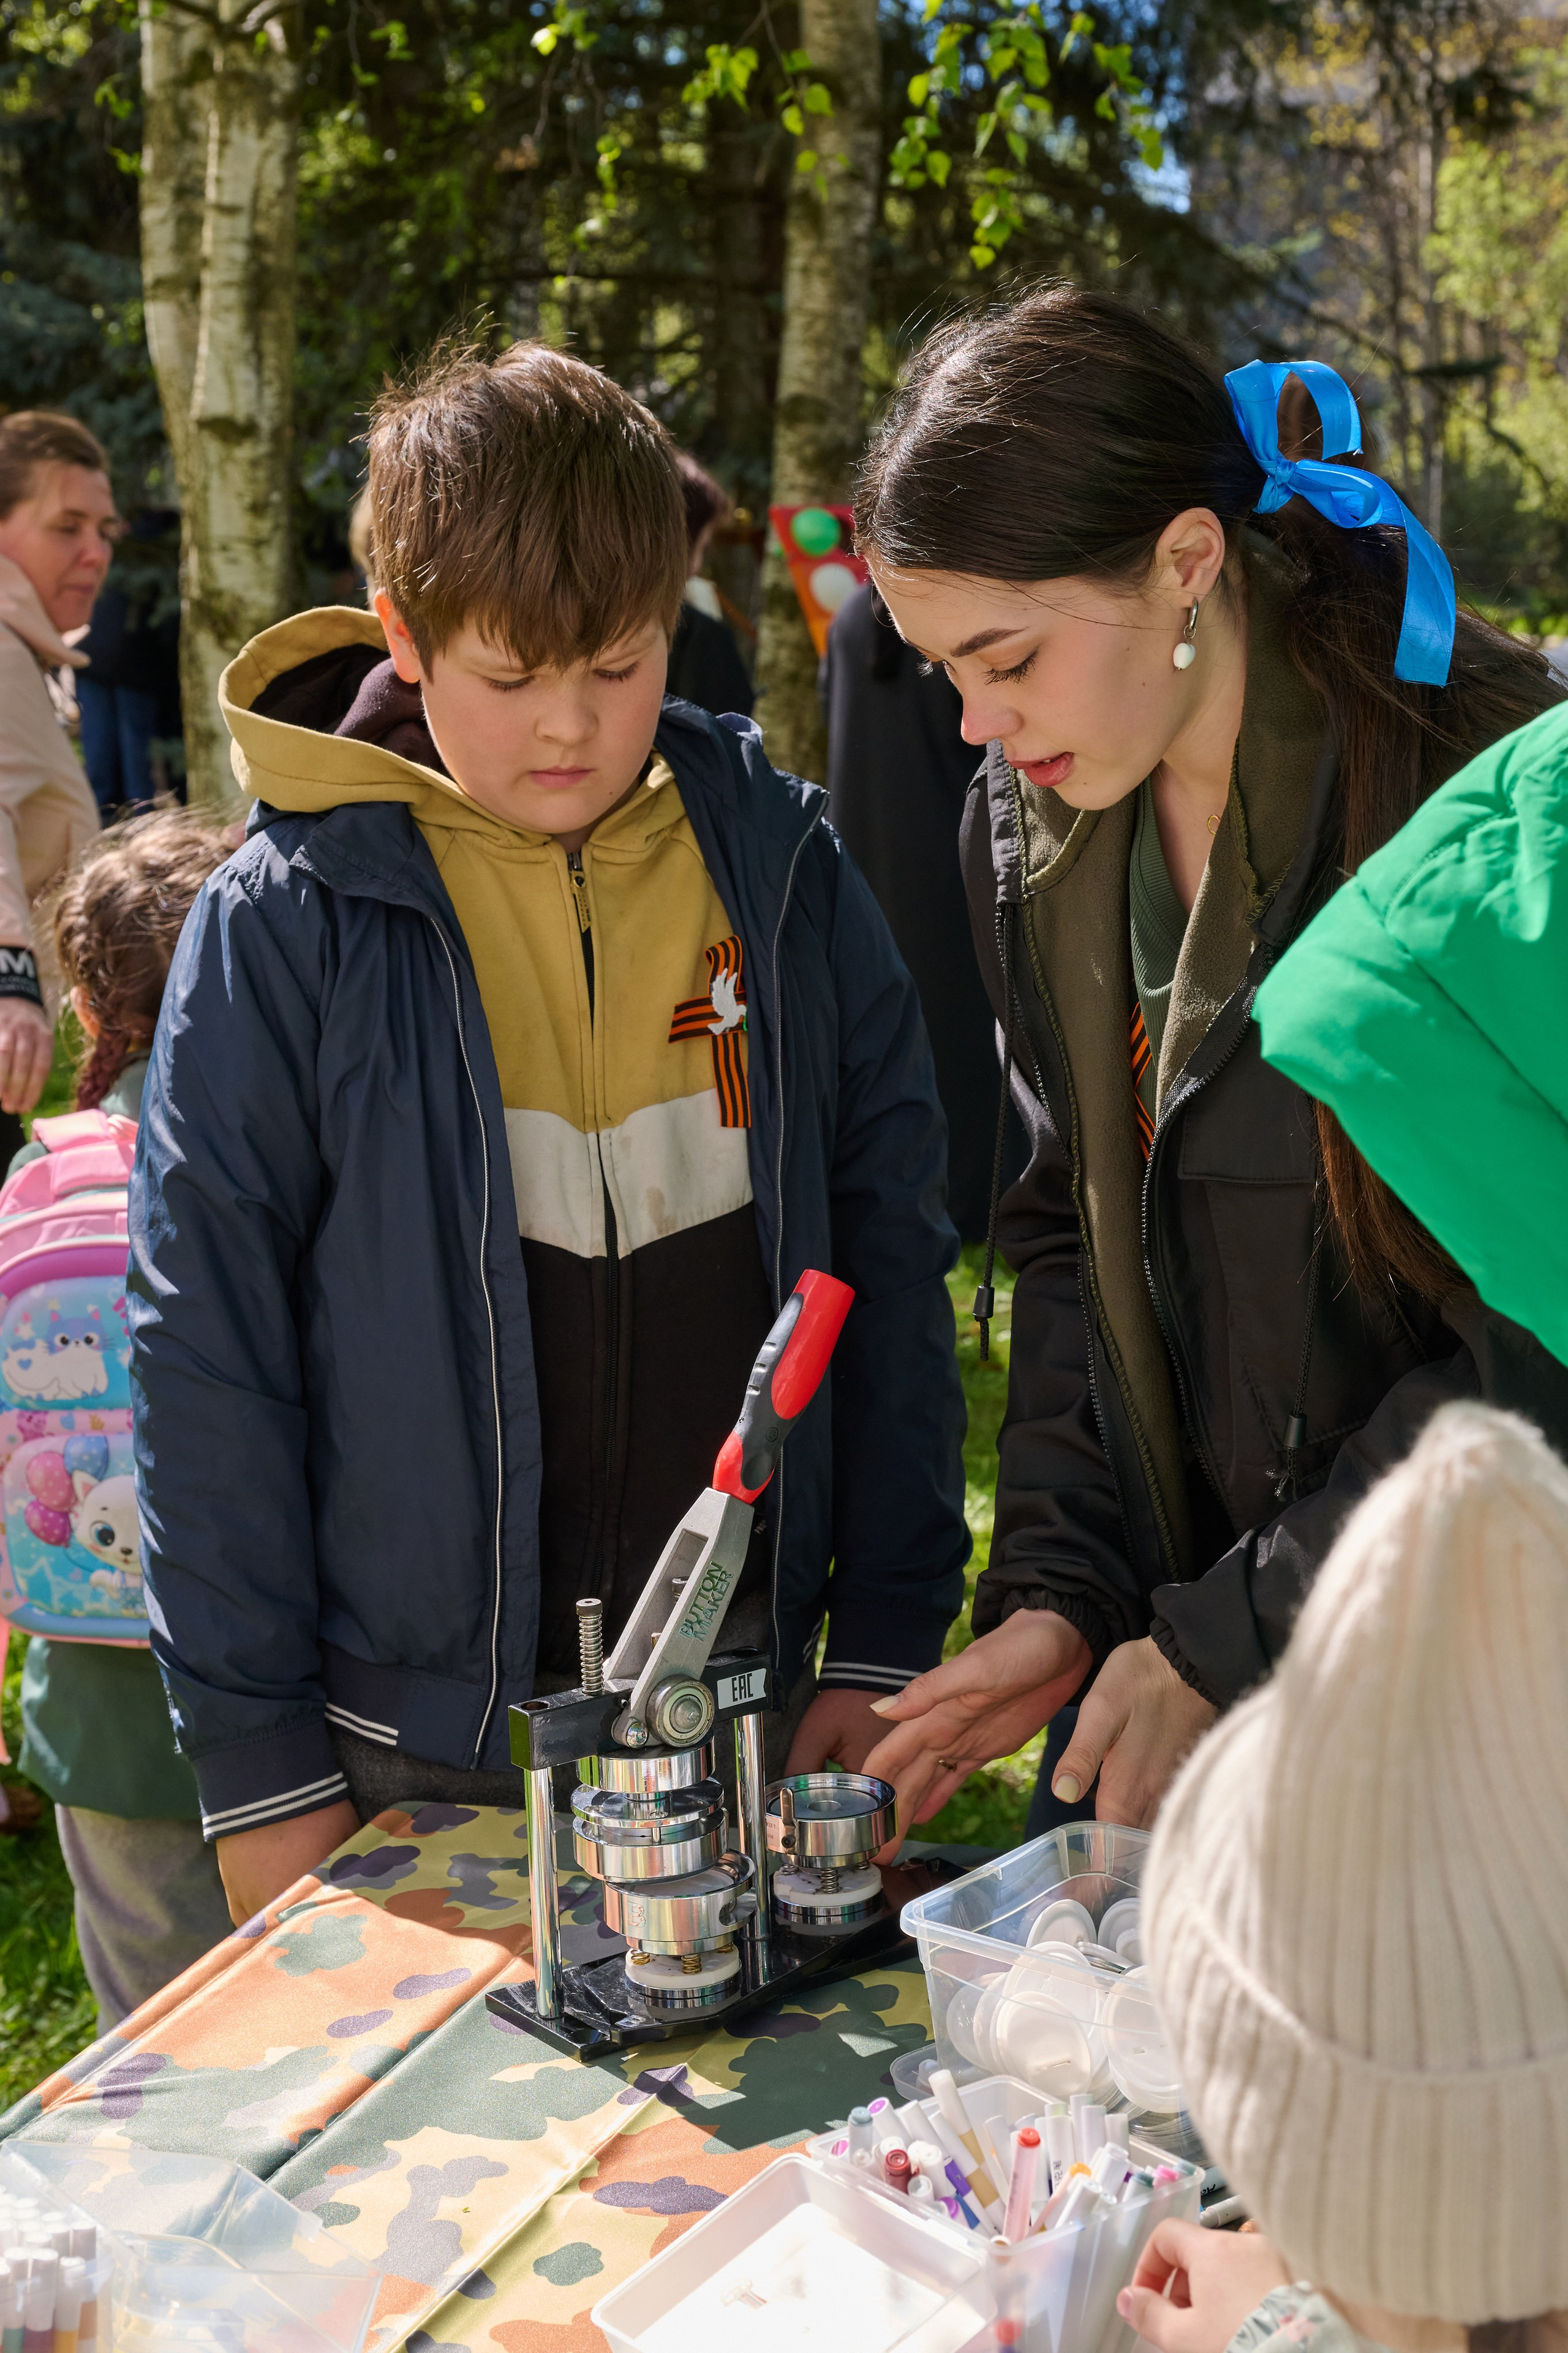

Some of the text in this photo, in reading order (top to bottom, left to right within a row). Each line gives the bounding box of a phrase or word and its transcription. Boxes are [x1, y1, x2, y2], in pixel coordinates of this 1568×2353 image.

[679, 1560, 725, 1639] BUTTON
[692, 1569, 733, 1642] MAKER
[731, 1672, 754, 1702] EAC
